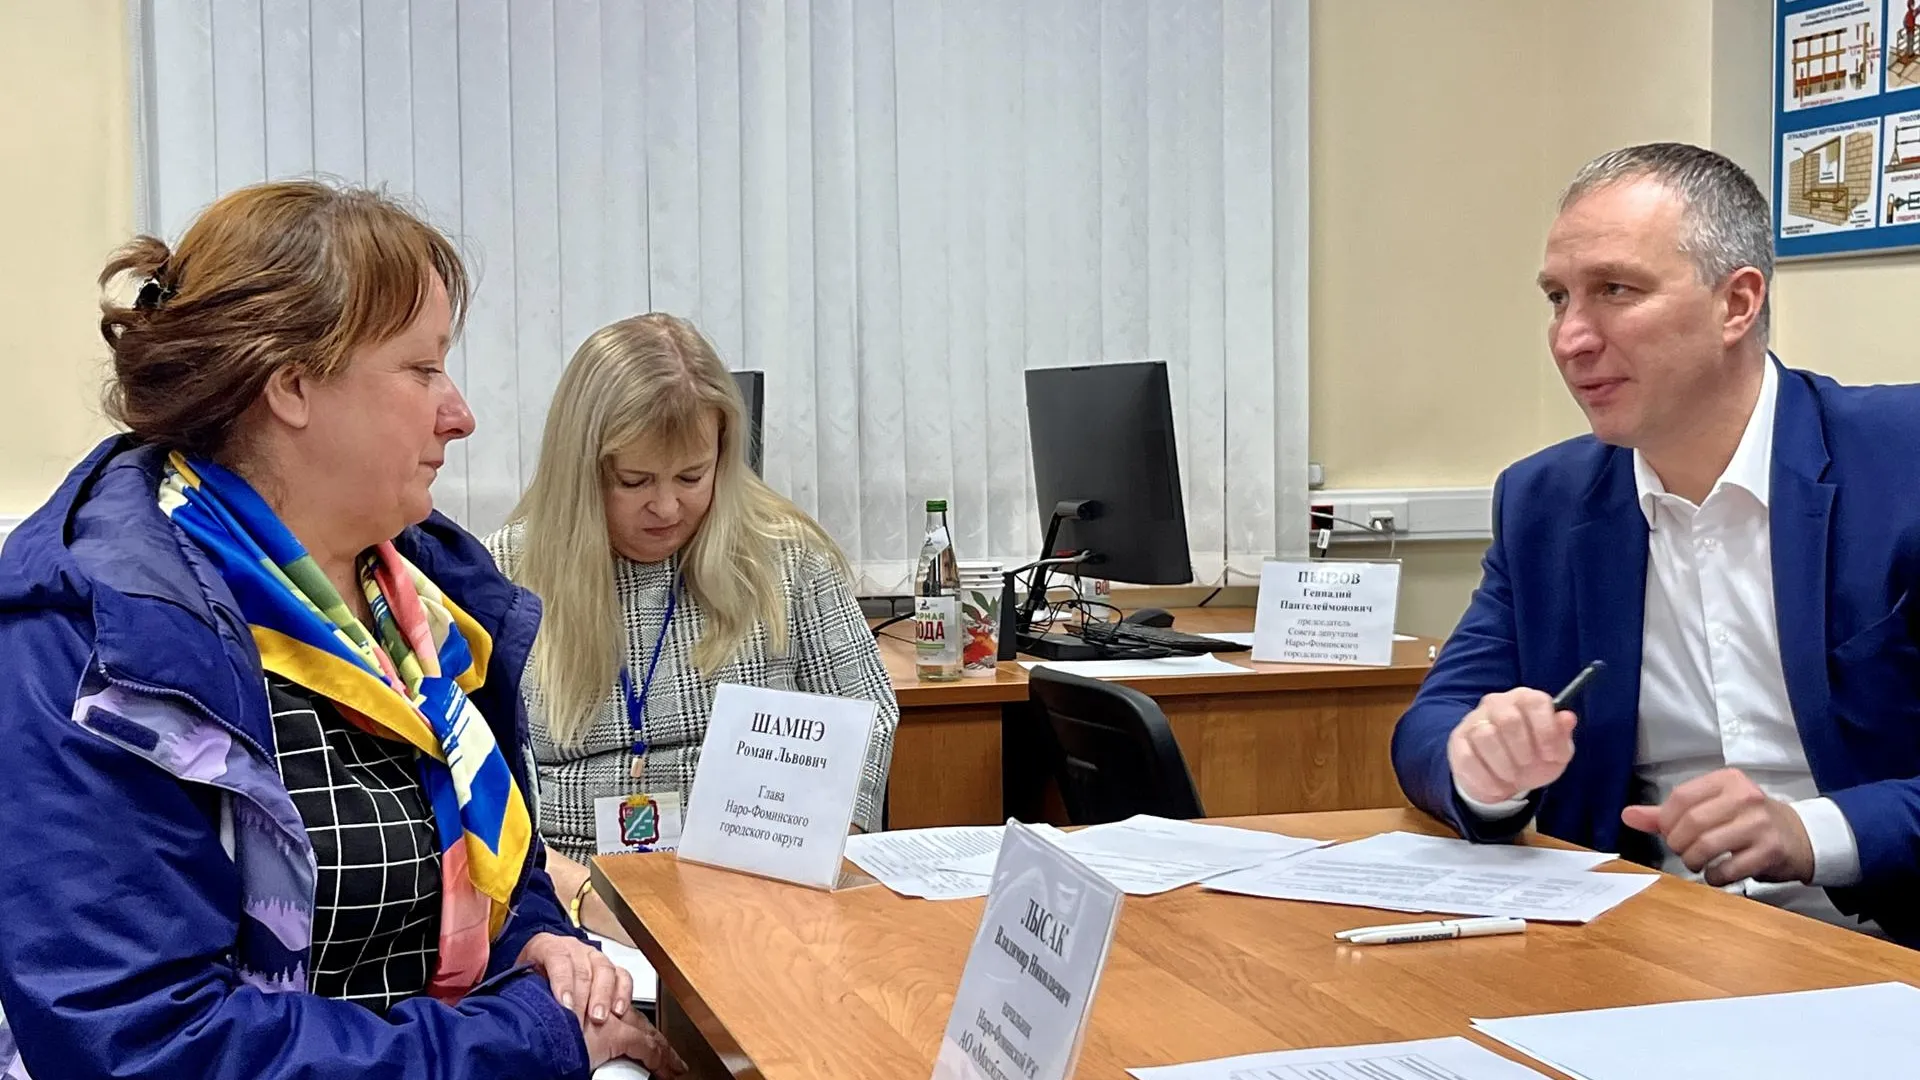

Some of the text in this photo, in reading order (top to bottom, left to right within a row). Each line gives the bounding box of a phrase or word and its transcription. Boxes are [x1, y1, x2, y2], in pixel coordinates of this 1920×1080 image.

[1303, 588, 1352, 598] Геннадий
[1280, 600, 1372, 612] Пантелеймонович
[1288, 627, 1359, 639] Совета депутатов
[1297, 619, 1351, 627] председатель
[1285, 638, 1359, 649] Наро-Фоминского
[1330, 653, 1358, 661] округа
[751, 712, 826, 742] ШАМНЭ
[736, 740, 828, 769] Роман Львович
[757, 785, 785, 802] Глава
[724, 799, 809, 827] Наро-Фоминского
[719, 821, 804, 848] городского округа
[1020, 898, 1070, 957] ЛЫСАК
[995, 924, 1072, 1008] Владимир Николаевич
[958, 1028, 974, 1053] АО
